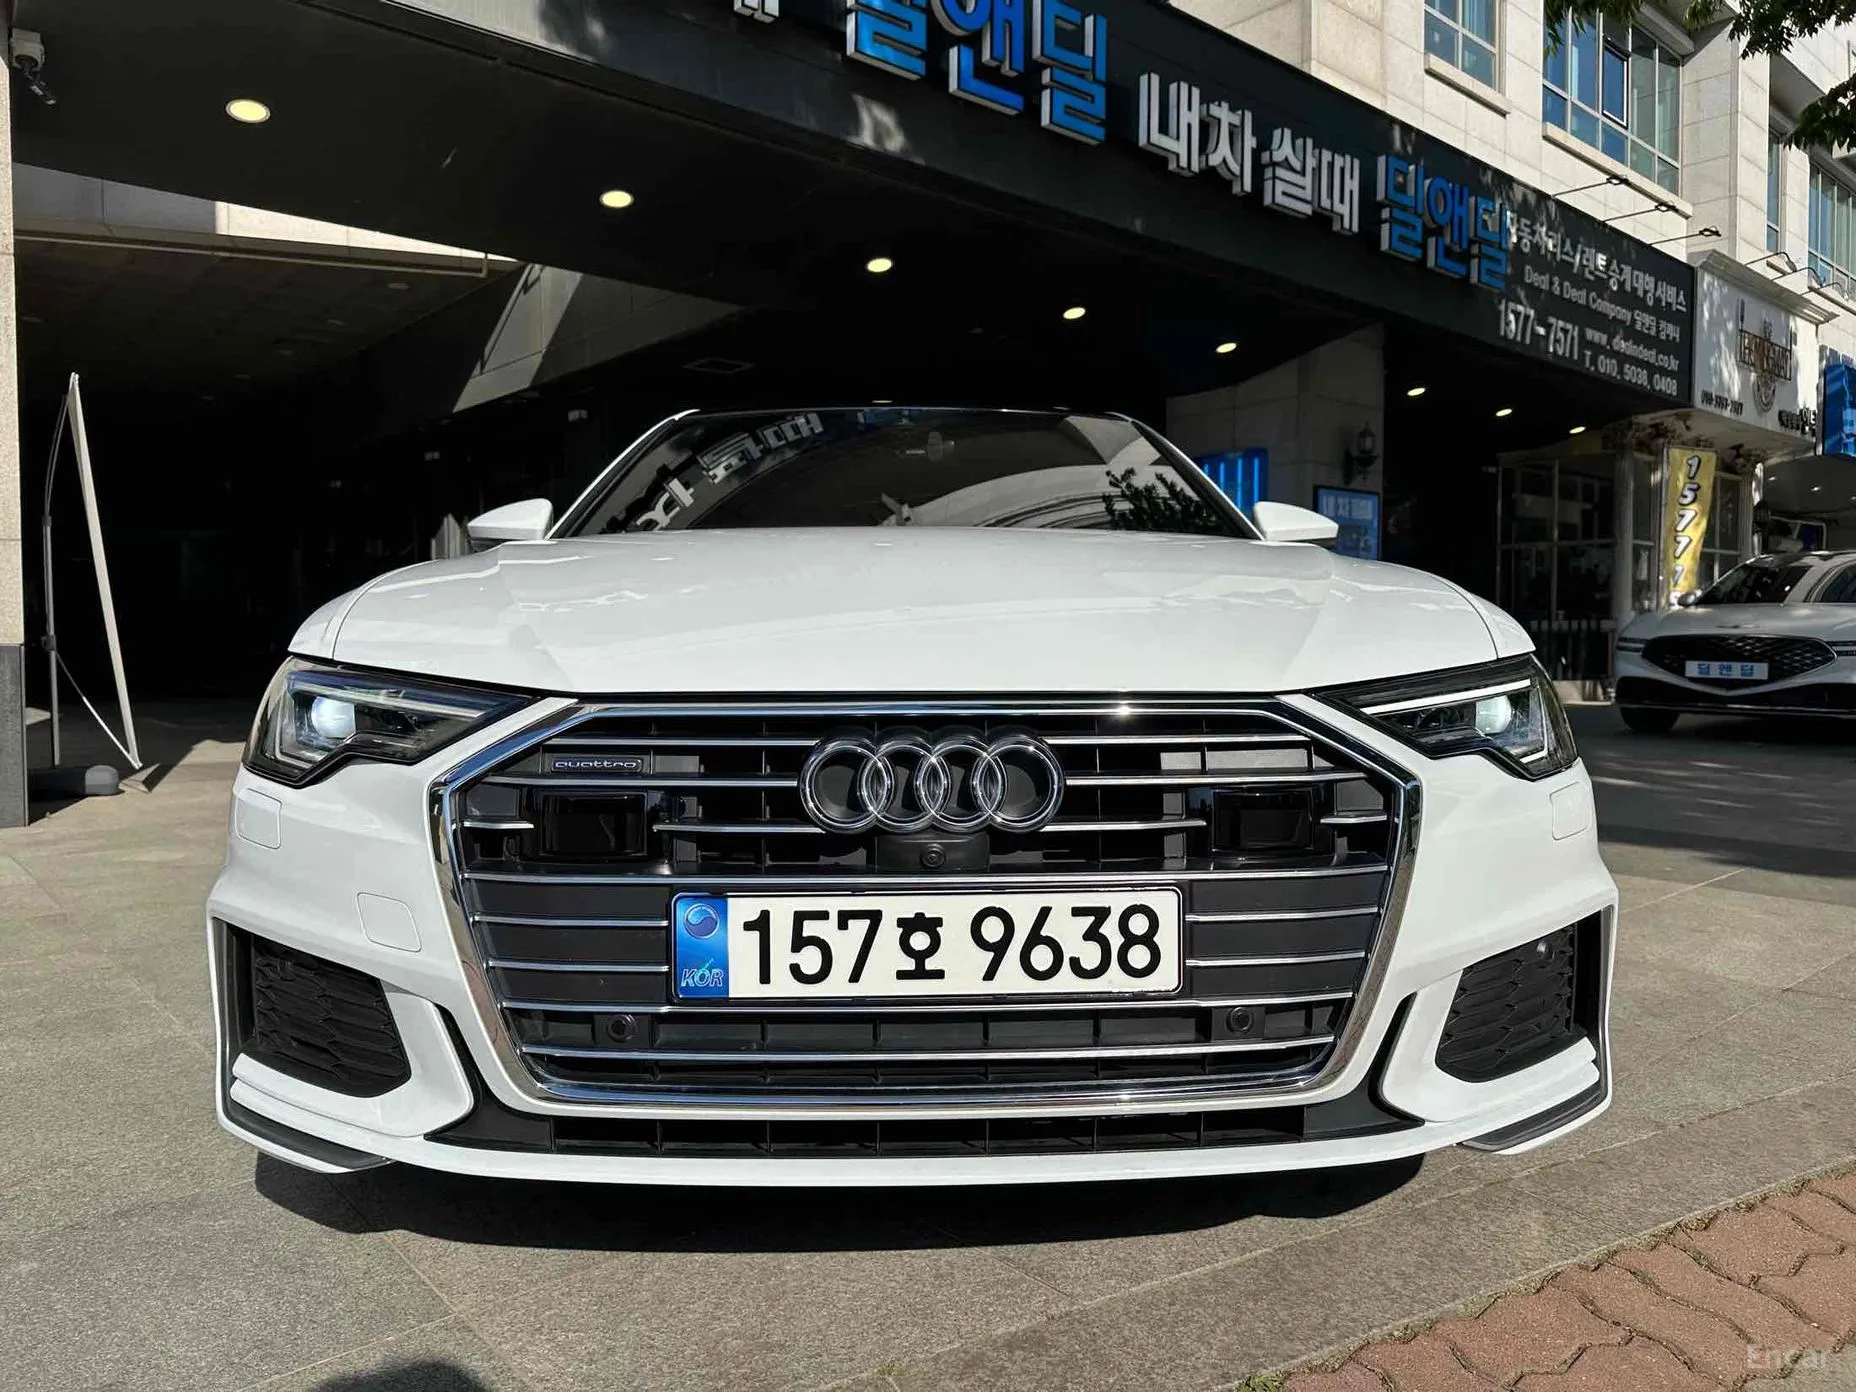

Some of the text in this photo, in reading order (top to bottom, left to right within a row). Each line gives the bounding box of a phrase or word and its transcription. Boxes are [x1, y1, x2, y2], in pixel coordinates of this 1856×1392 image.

[1138, 72, 1256, 196] 내차
[1261, 127, 1360, 235] 살때
[1377, 154, 1508, 290] 딜앤딜
[1524, 266, 1549, 291] Deal
[1552, 276, 1560, 295] &
[1563, 281, 1587, 306] Deal
[1589, 292, 1631, 326] Company
[555, 760, 637, 769] quattro
[743, 904, 1162, 985] 157호 9638
[680, 967, 724, 988] KOR
